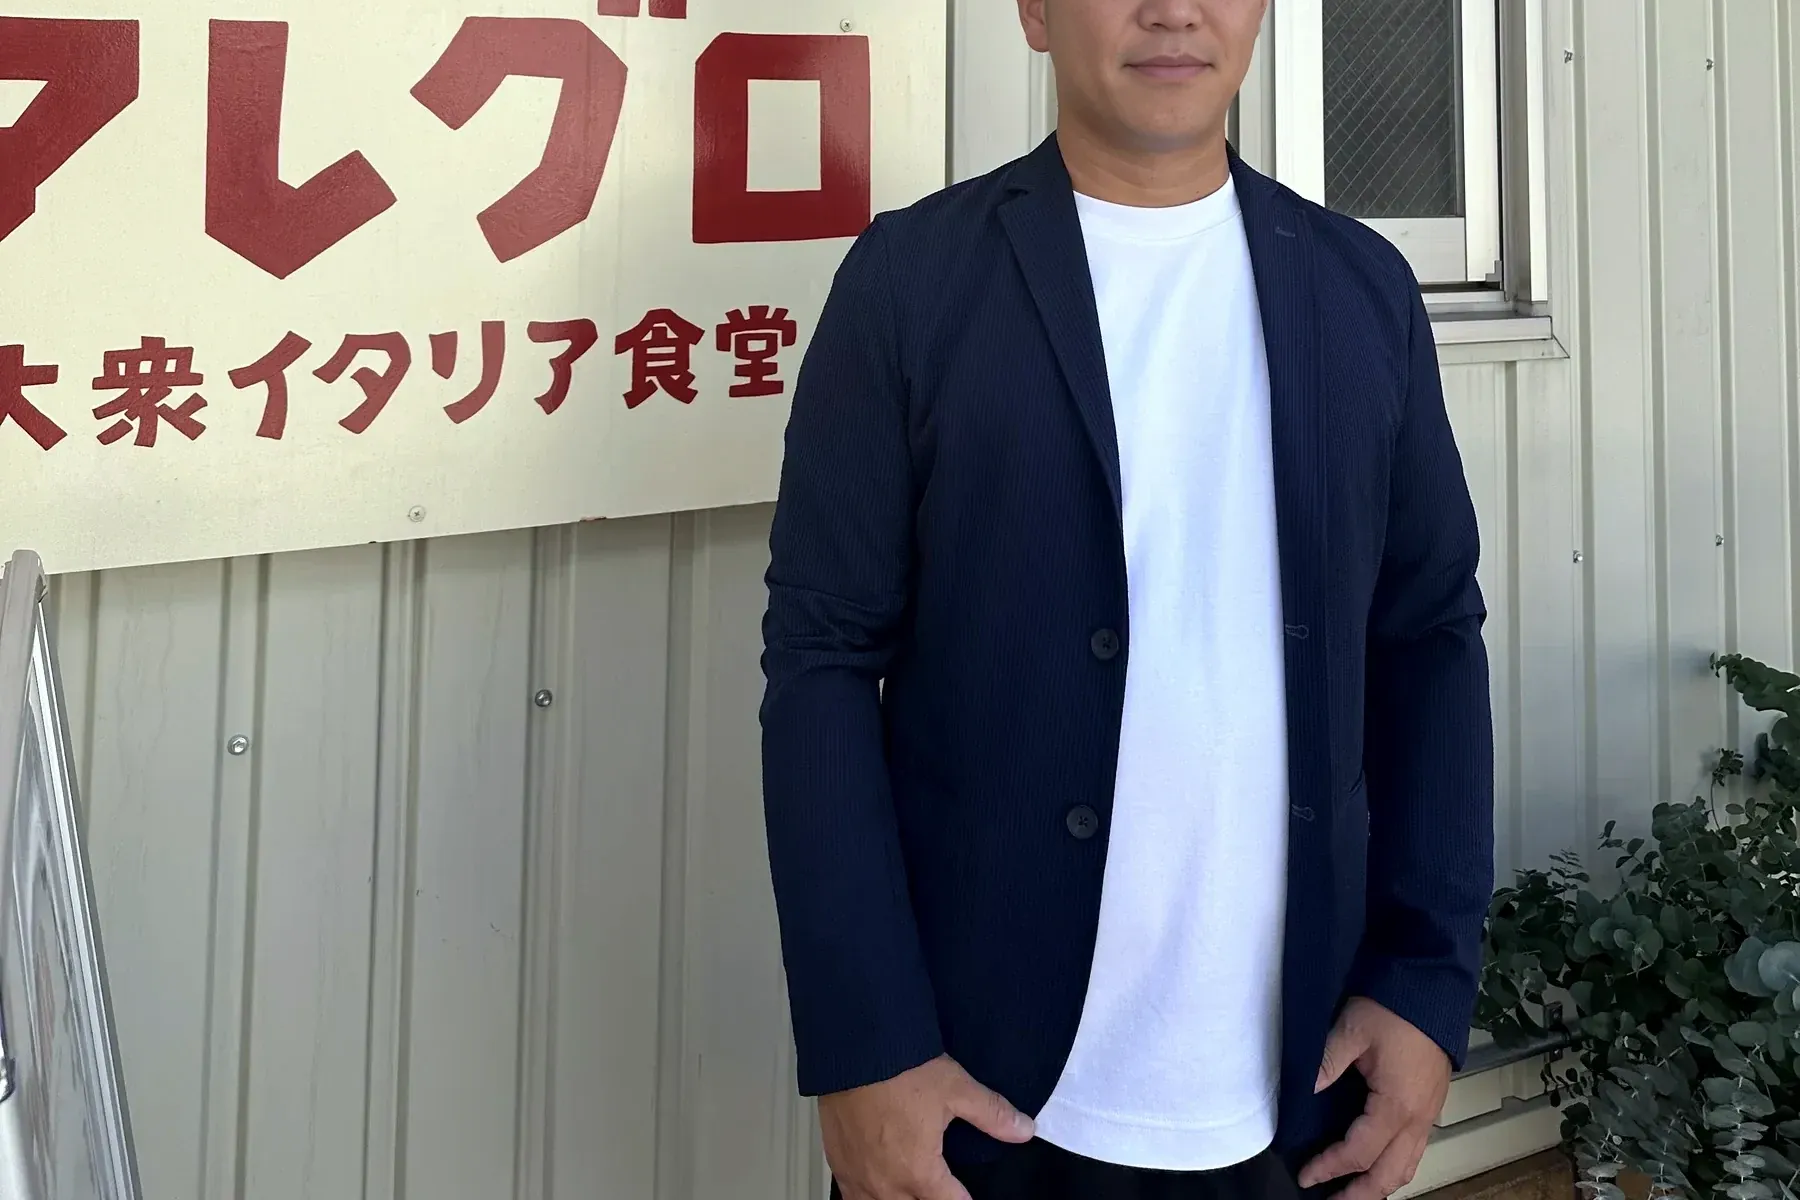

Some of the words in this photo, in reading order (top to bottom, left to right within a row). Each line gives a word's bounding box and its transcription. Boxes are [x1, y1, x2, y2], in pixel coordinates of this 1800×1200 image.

[0, 307, 796, 448] 大衆イタリア食堂
